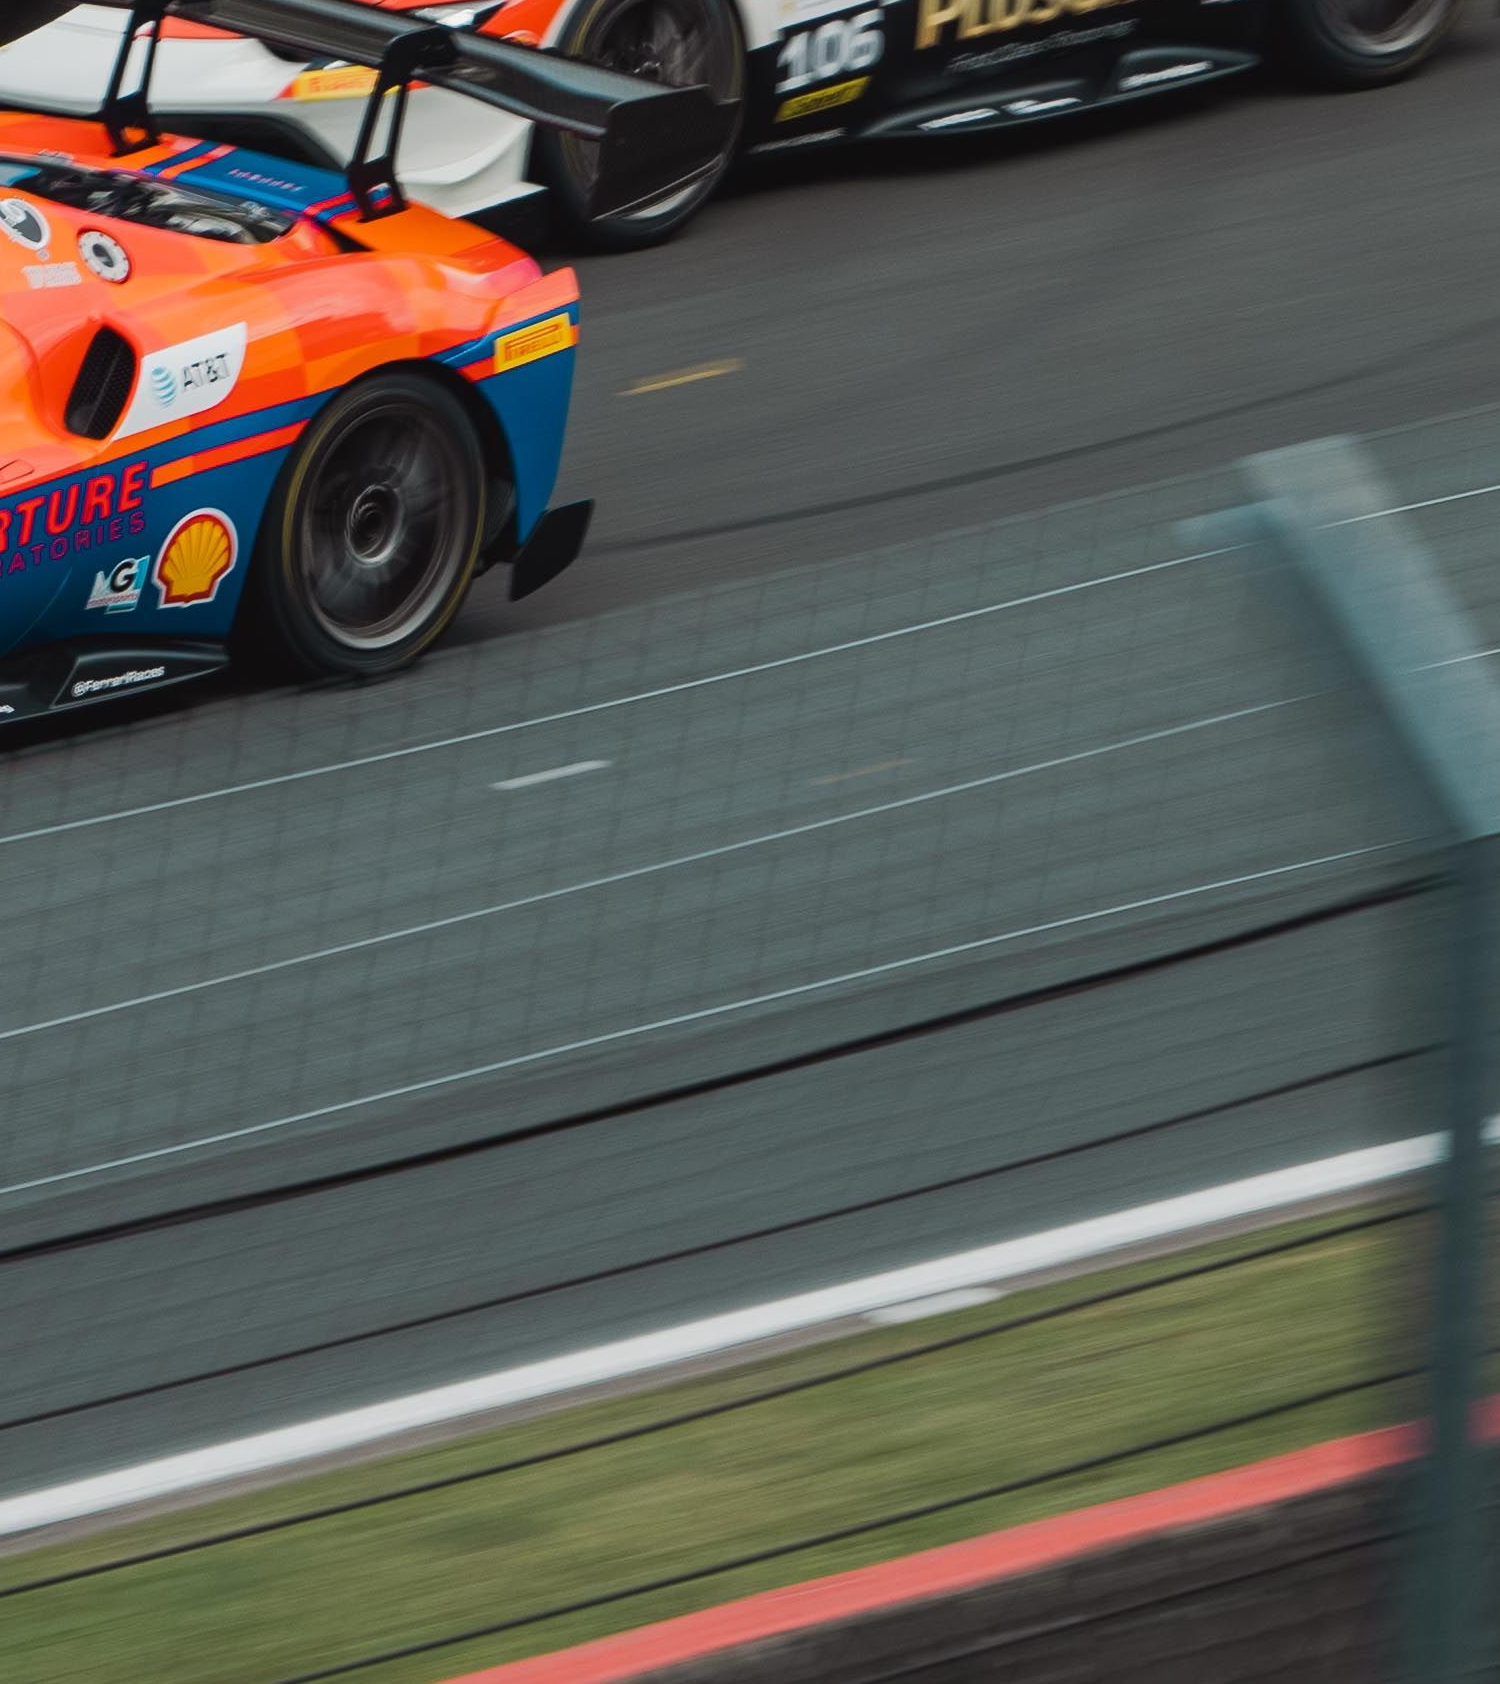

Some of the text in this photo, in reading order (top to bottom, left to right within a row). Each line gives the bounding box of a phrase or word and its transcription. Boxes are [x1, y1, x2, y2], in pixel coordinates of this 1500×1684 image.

[775, 8, 886, 94] 106
[504, 324, 563, 364] PIRELLI
[181, 352, 232, 394] AT&T
